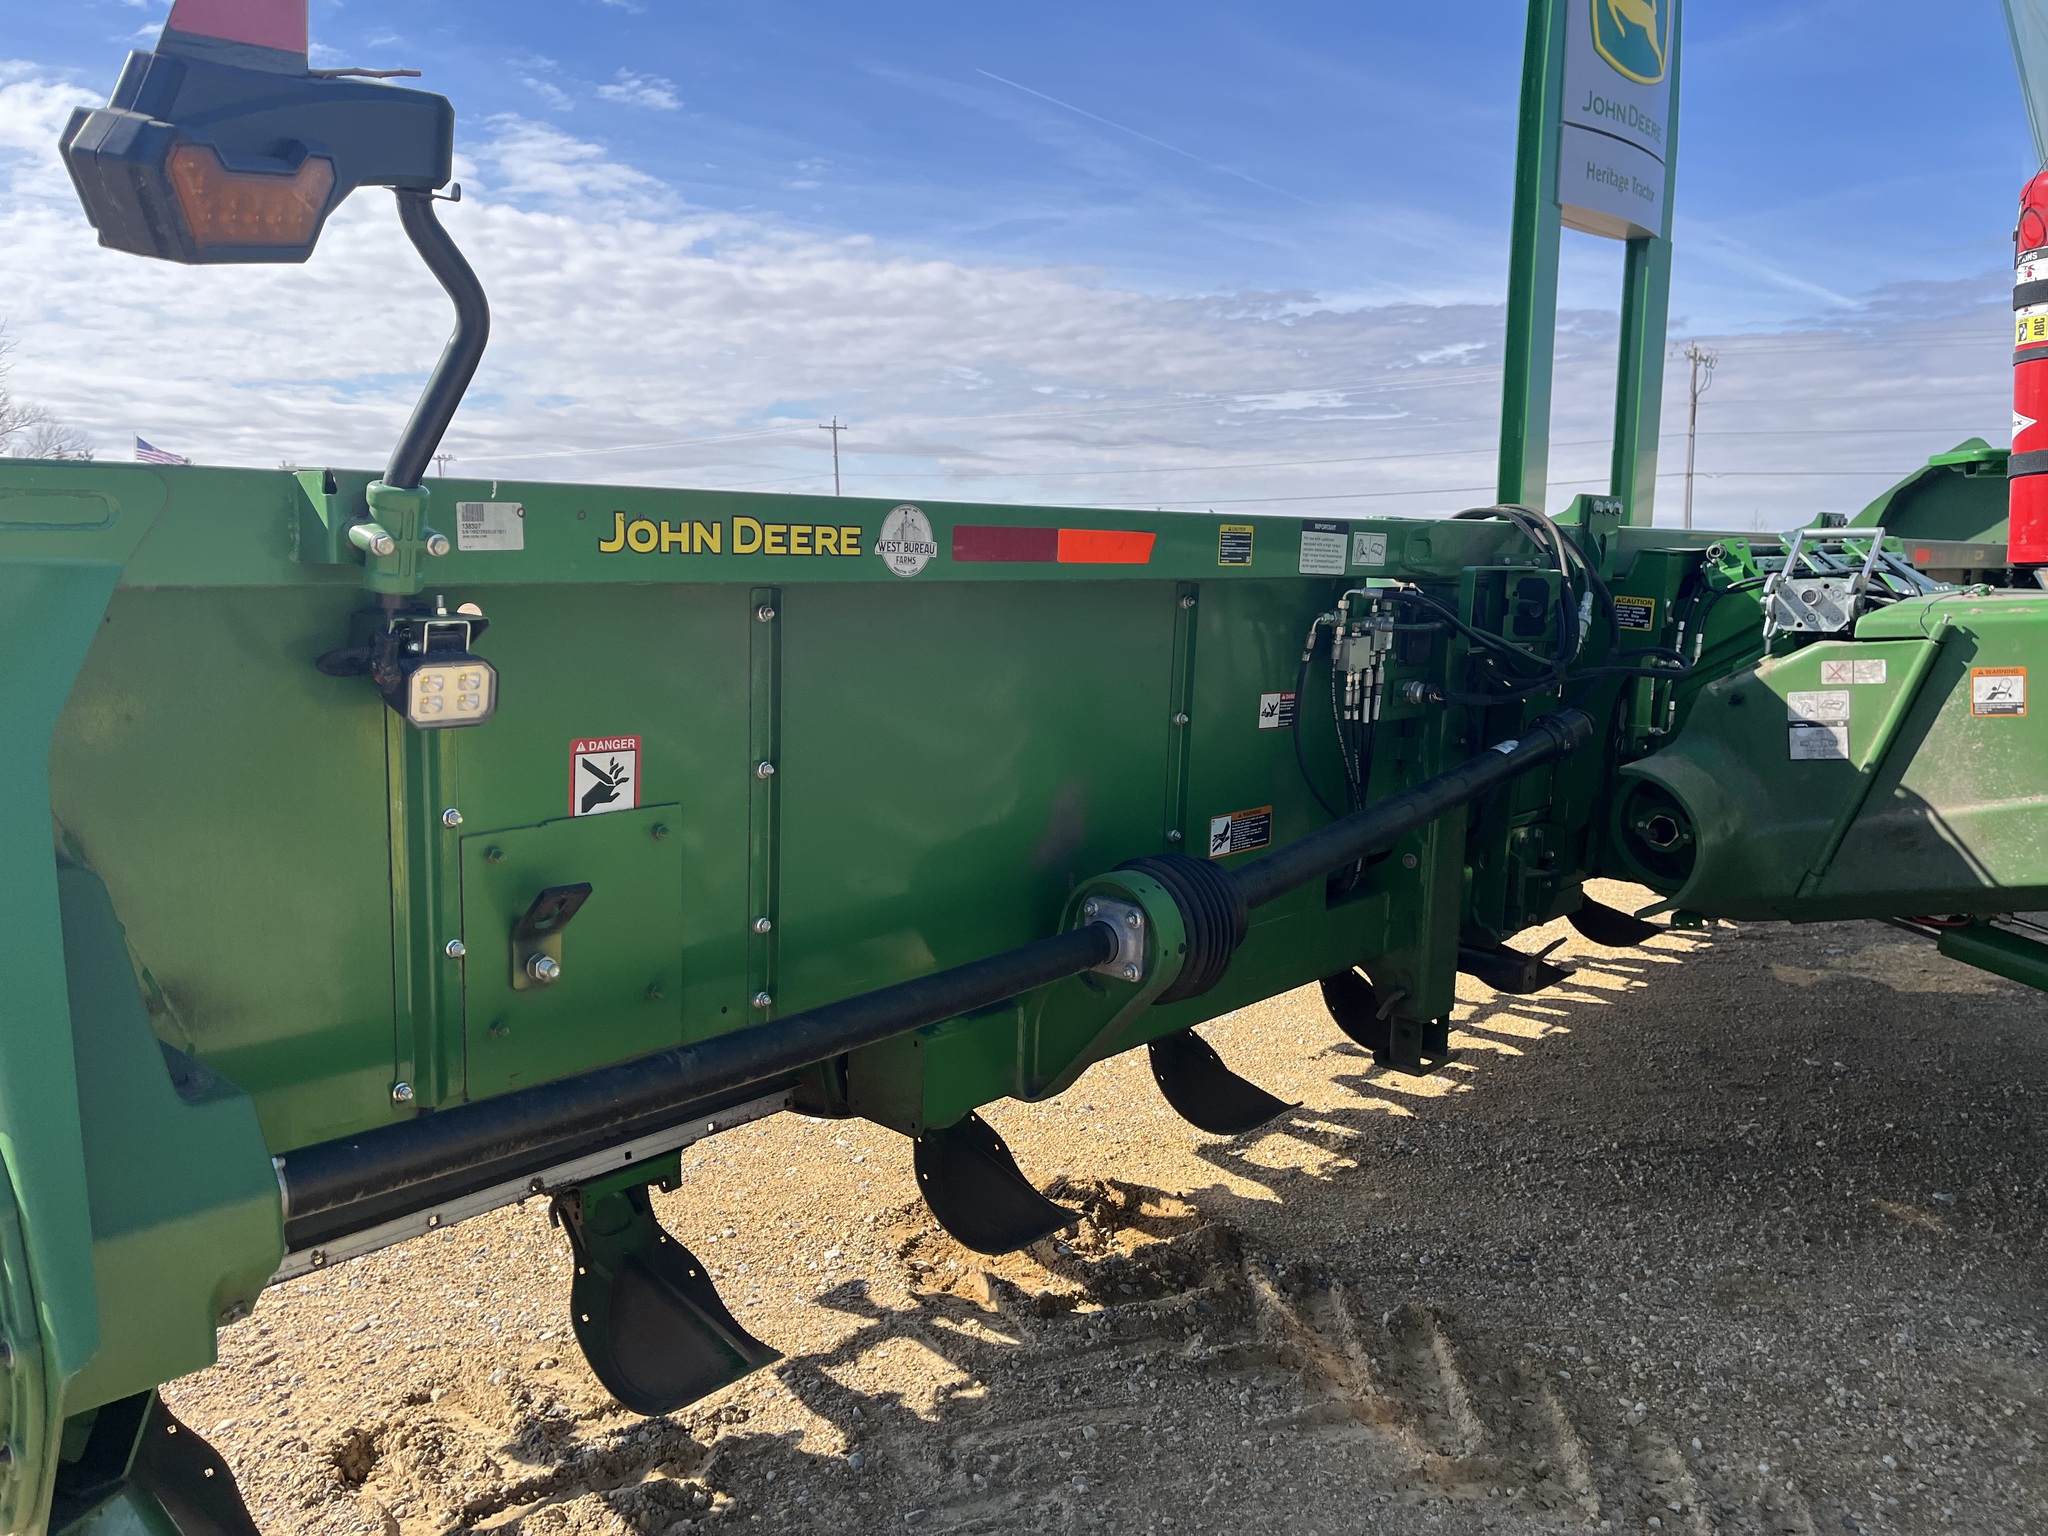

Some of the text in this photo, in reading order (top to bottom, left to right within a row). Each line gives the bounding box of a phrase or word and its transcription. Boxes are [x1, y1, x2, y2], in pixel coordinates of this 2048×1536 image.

[1582, 90, 1662, 144] JOHN DEERE
[1586, 161, 1655, 204] Heritage Tractor
[2034, 317, 2045, 336] ABC
[599, 510, 863, 556] JOHN DEERE
[878, 541, 935, 555] WEST BUREAU
[895, 555, 916, 565] FARMS
[1622, 598, 1652, 606] CAUTION
[588, 738, 636, 751] DANGER
